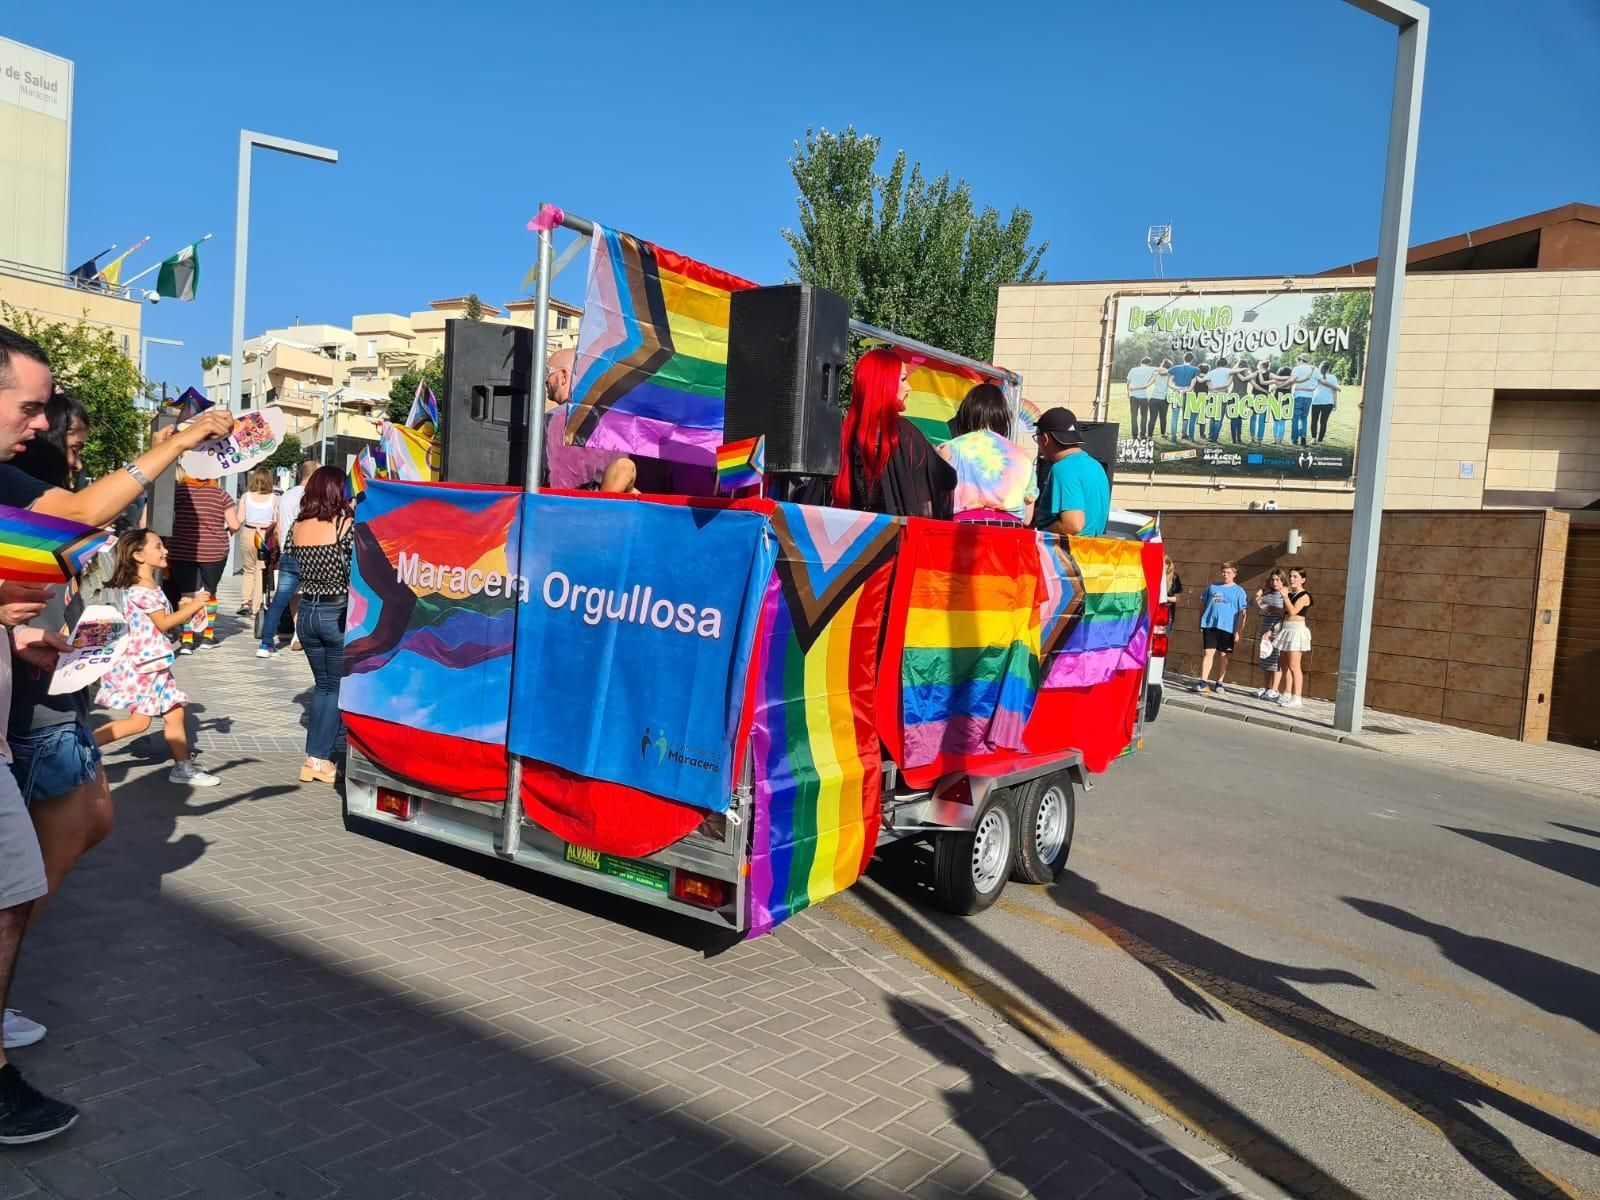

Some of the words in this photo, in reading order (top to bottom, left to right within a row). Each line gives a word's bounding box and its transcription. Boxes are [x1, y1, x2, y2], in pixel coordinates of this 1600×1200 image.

[5, 65, 20, 80] de
[24, 71, 58, 94] Salud
[20, 84, 58, 105] Maracena
[1199, 326, 1280, 353] espacio
[542, 571, 722, 639] Orgullosa
[668, 749, 719, 772] Maracena
